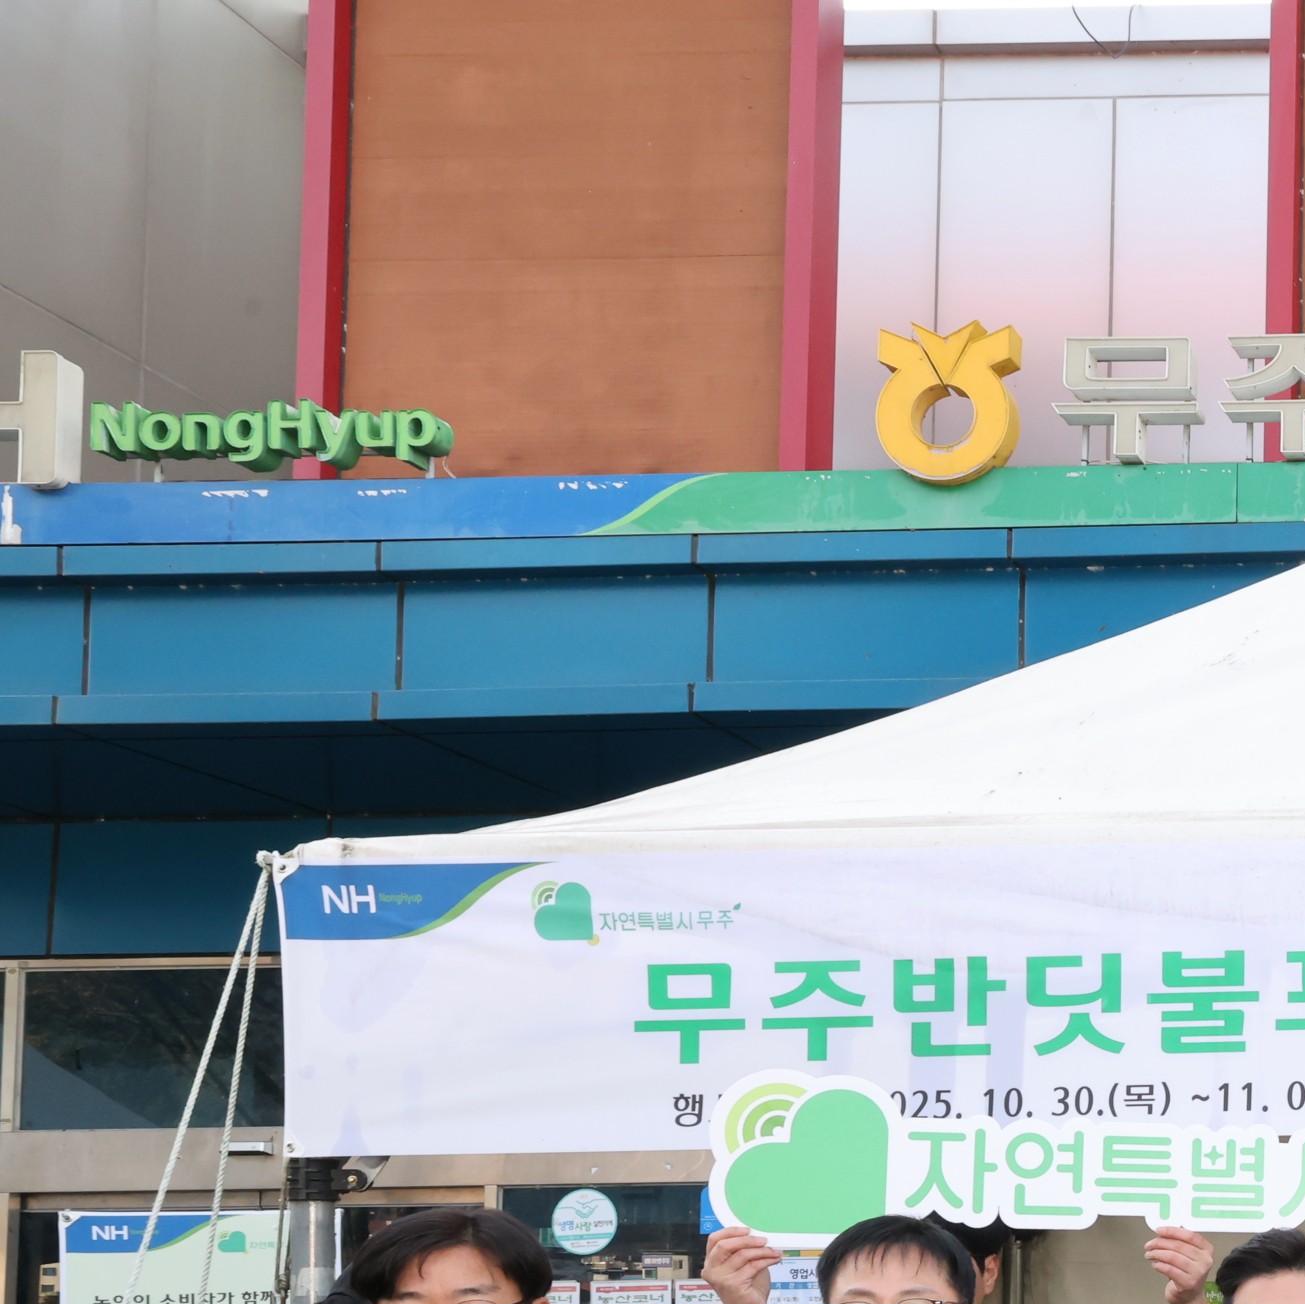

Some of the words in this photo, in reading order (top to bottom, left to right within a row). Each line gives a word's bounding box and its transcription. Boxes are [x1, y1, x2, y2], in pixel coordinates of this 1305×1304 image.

[91, 399, 453, 472] NongHyup
[323, 884, 376, 915] NH
[673, 1092, 713, 1127] 행
[91, 1225, 129, 1241] NH
